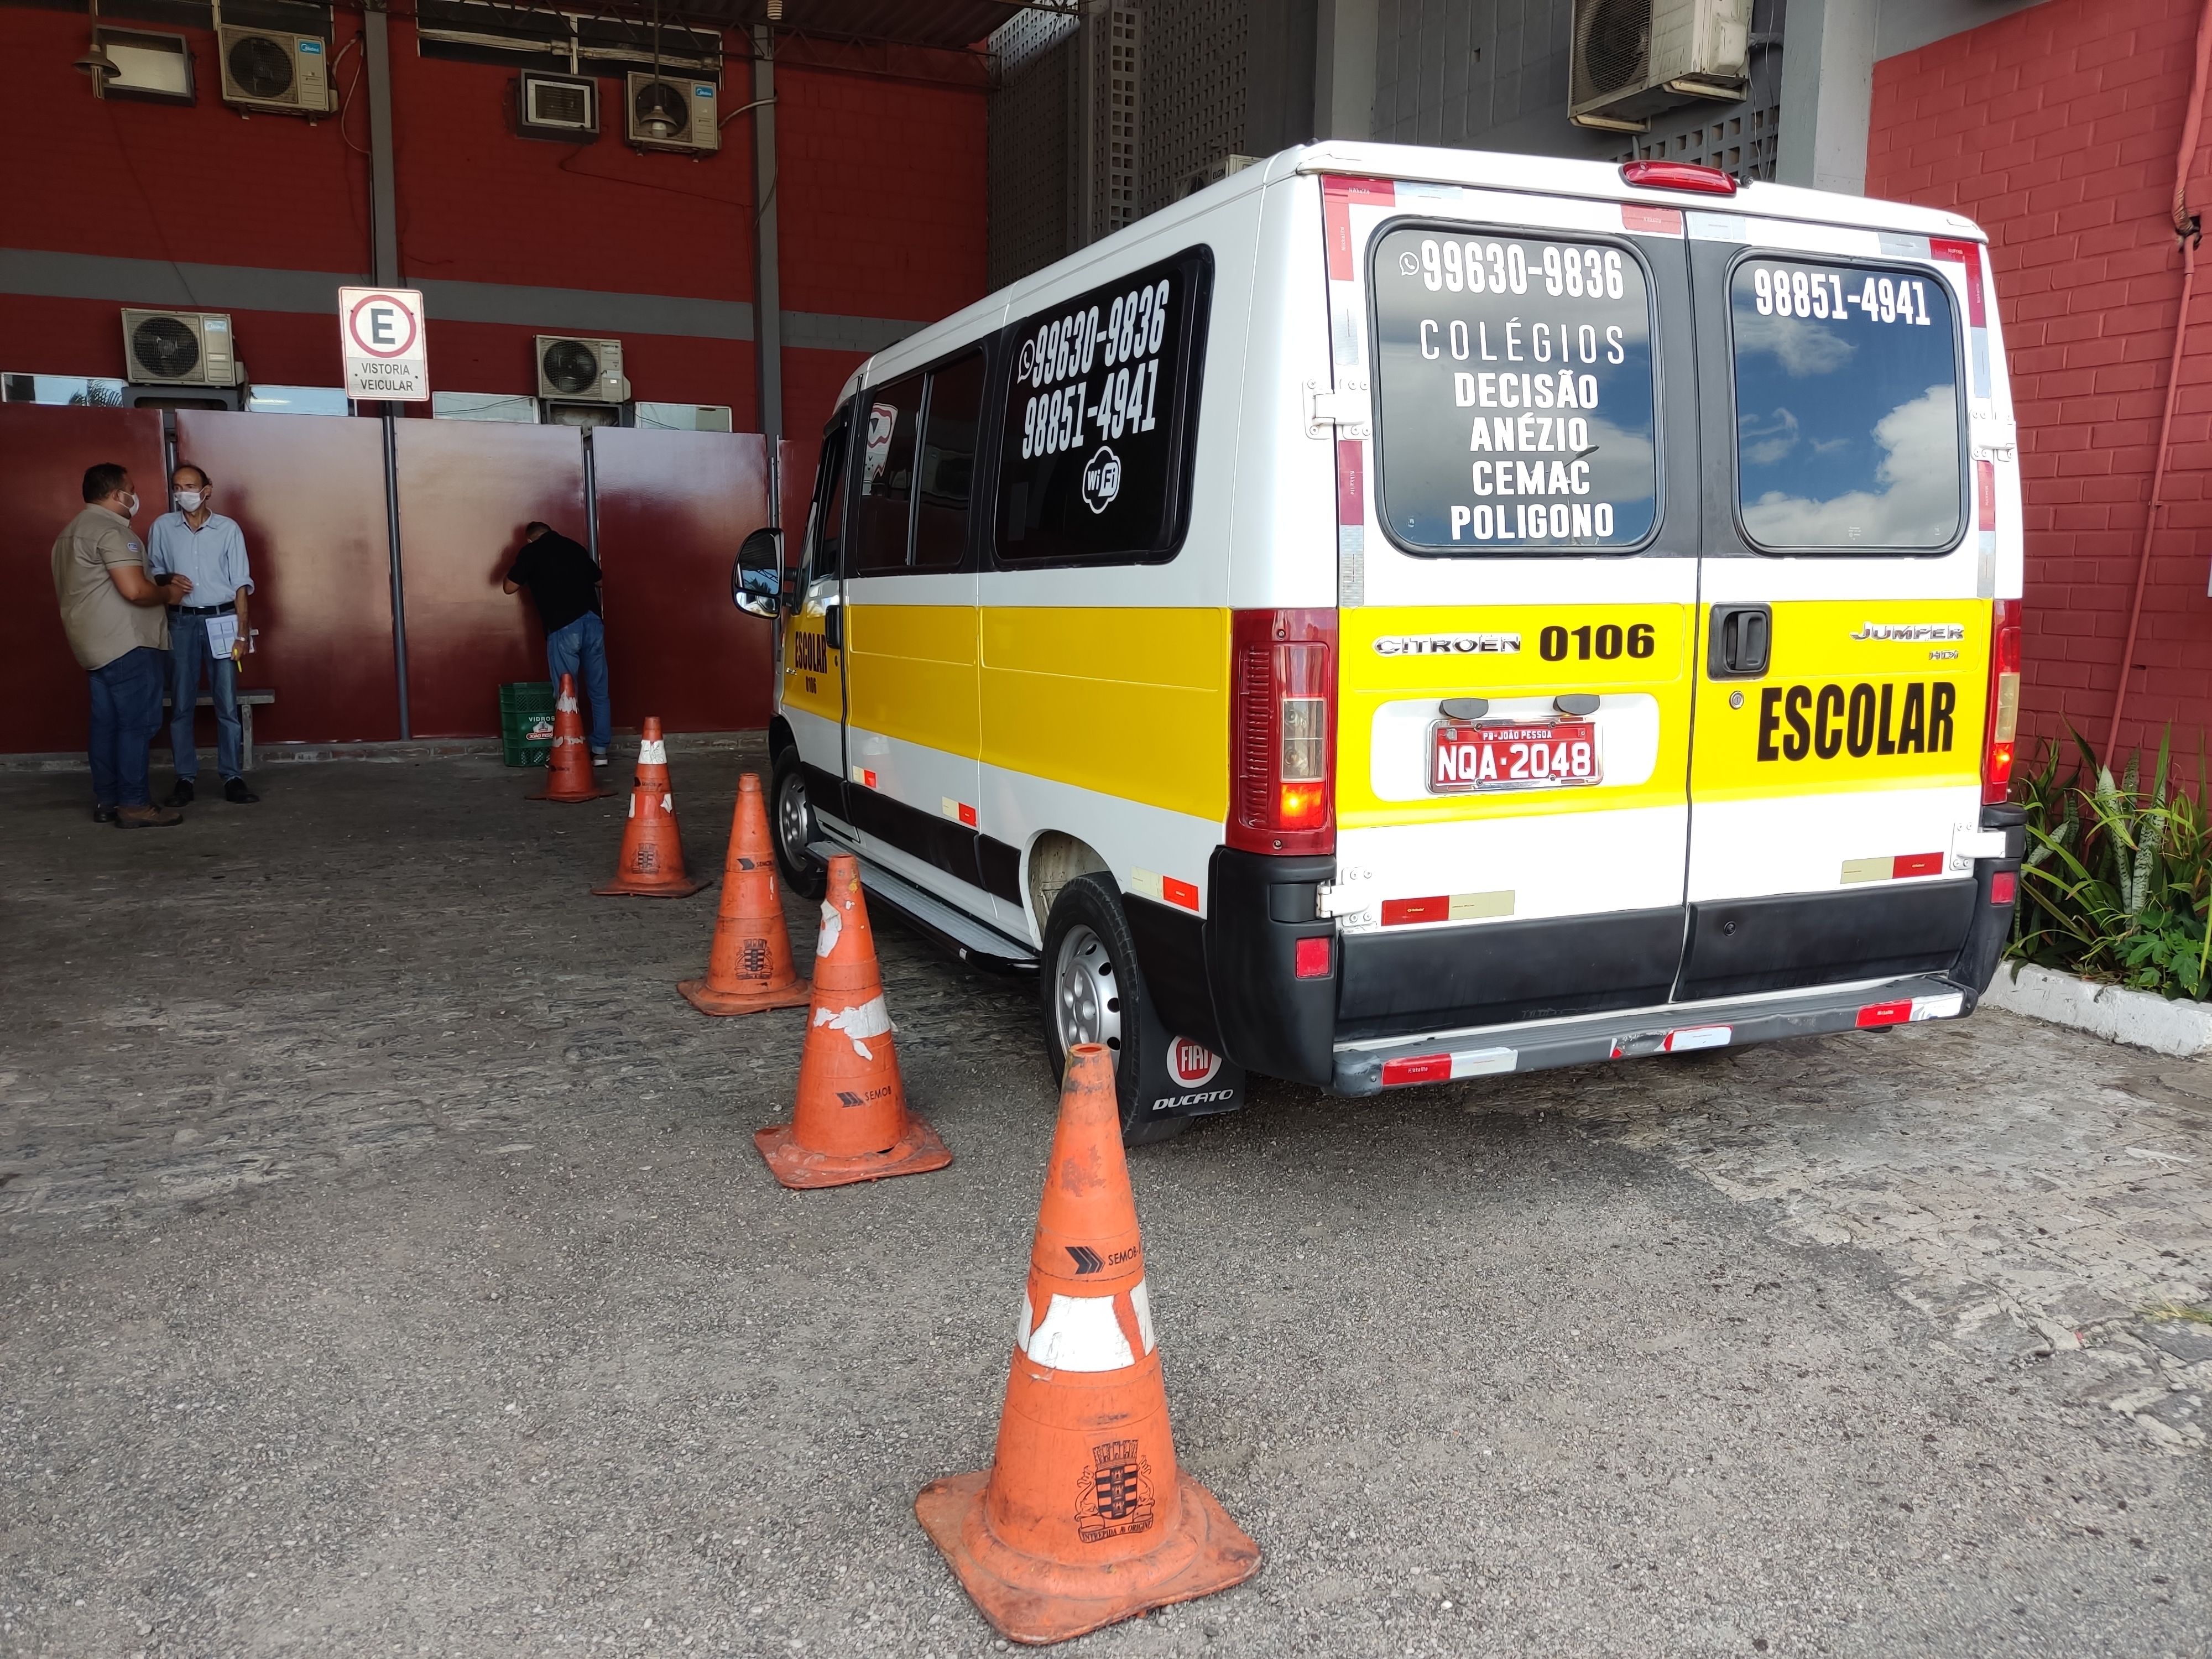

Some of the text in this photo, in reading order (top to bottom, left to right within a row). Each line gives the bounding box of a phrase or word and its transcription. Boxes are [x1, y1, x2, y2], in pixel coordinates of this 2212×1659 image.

[1421, 239, 1624, 300] 99630-9836
[1754, 268, 1931, 326] 98851-4941
[371, 308, 395, 345] E
[1032, 279, 1170, 388] 99630-9836
[1420, 316, 1625, 364] COLÉGIOS
[360, 379, 414, 392] VEICULAR
[361, 363, 410, 375] VISTORIA
[1454, 369, 1598, 409] DECISÃO
[1022, 359, 1159, 460] 98851-4941
[1470, 411, 1589, 452] ANÉZIO
[1472, 460, 1590, 497] CEMAC
[1451, 503, 1614, 540] POLIGONO
[795, 631, 827, 674] ESCOLAR
[1540, 623, 1655, 662] 0106
[1521, 730, 1552, 739] PESSOA
[1757, 681, 1956, 762] ESCOLAR
[1181, 1045, 1208, 1072] FIAT
[1152, 1089, 1234, 1110] DUCATO
